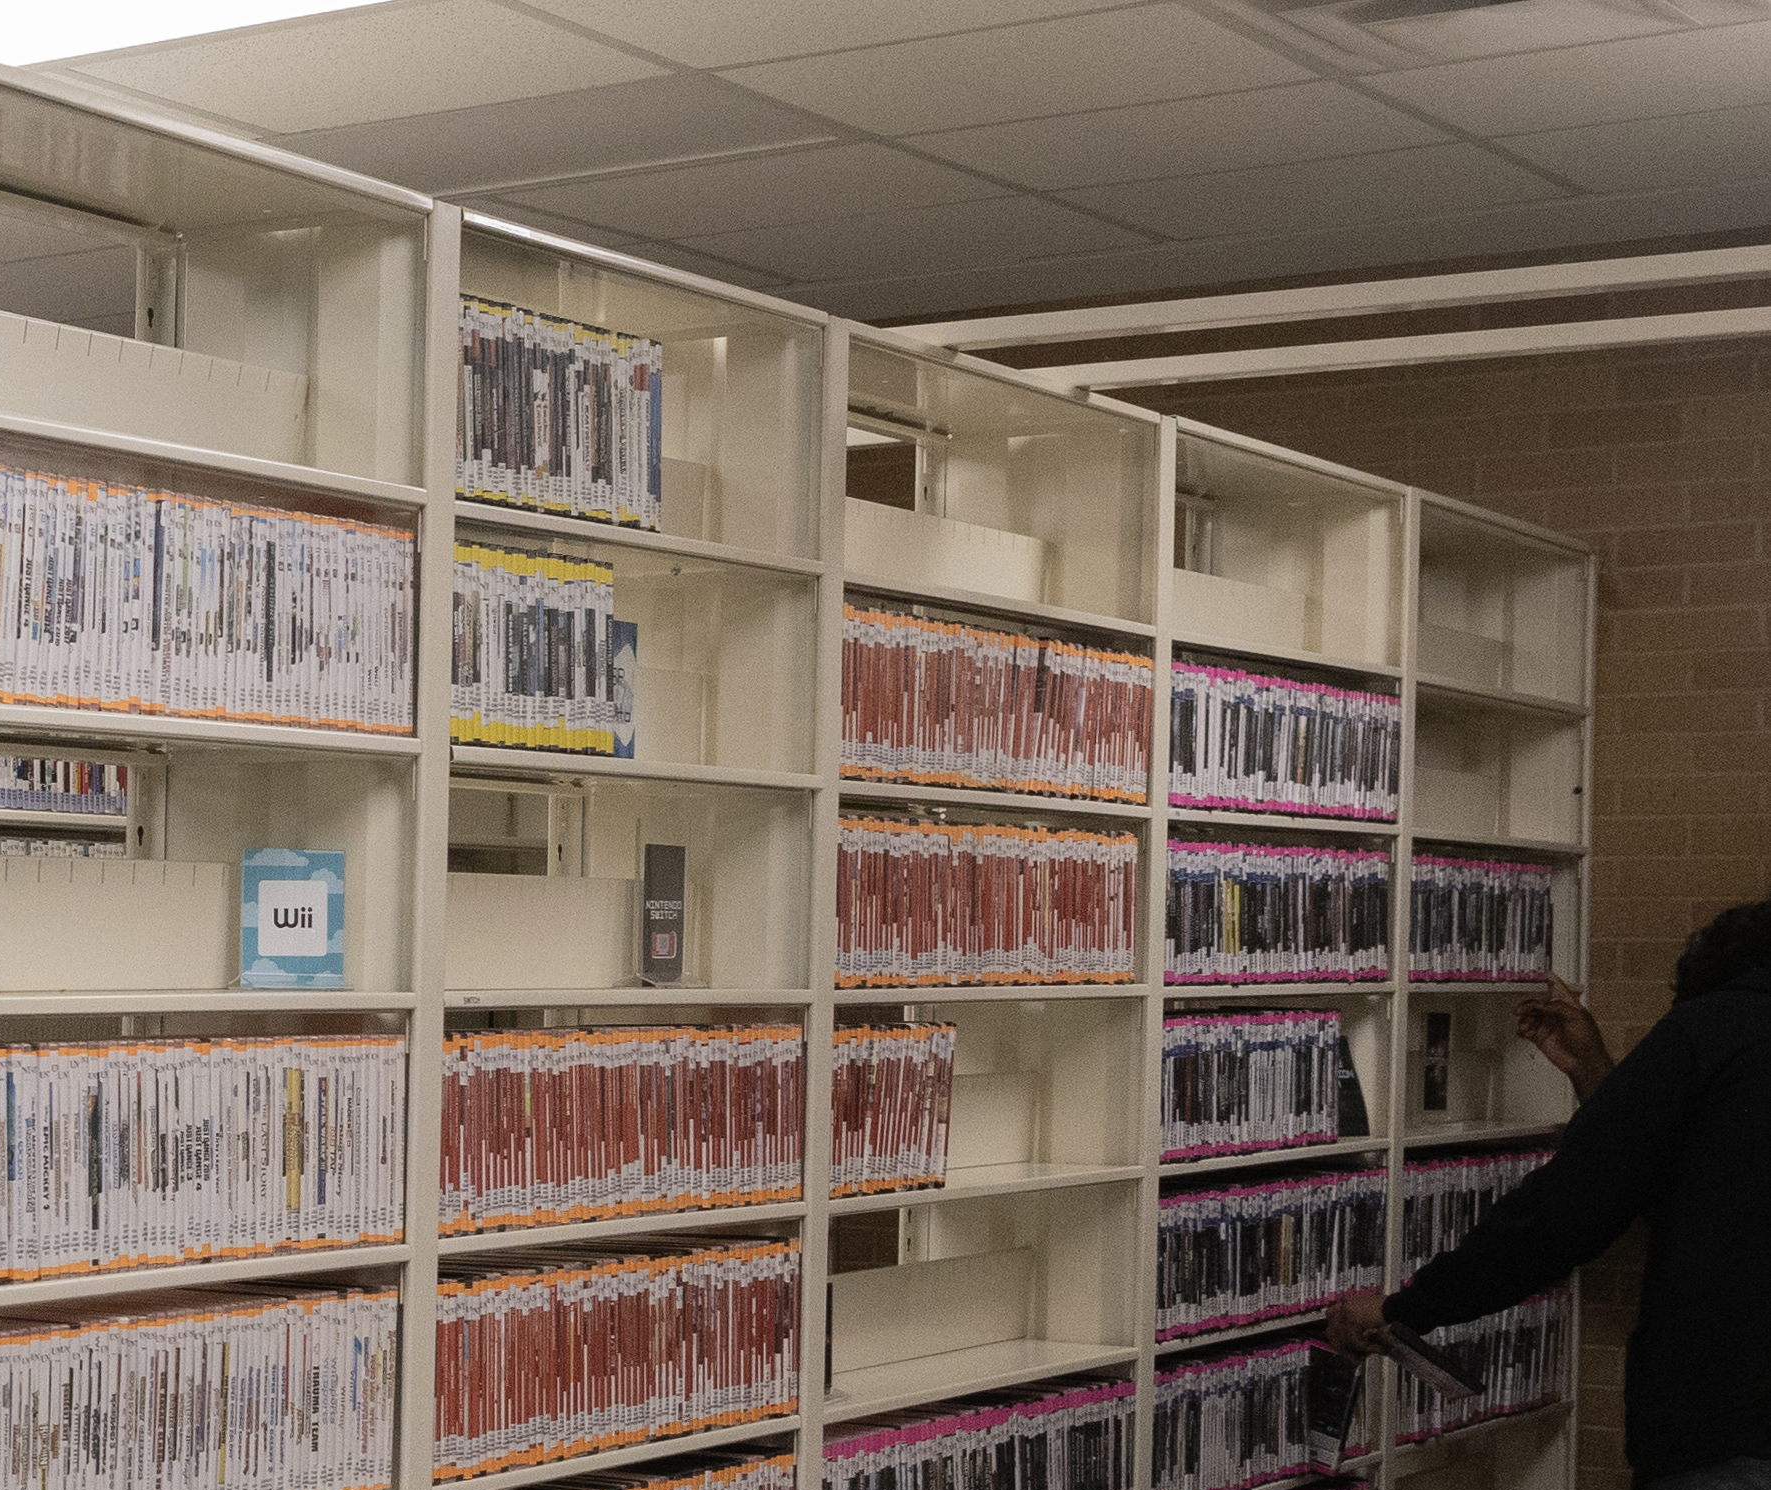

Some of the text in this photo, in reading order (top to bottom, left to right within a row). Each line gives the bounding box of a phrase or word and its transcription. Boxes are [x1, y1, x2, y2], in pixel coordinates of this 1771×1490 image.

[645, 900, 683, 910] NINTENDO
[273, 906, 313, 929] Wii
[650, 910, 678, 920] SWITCH
